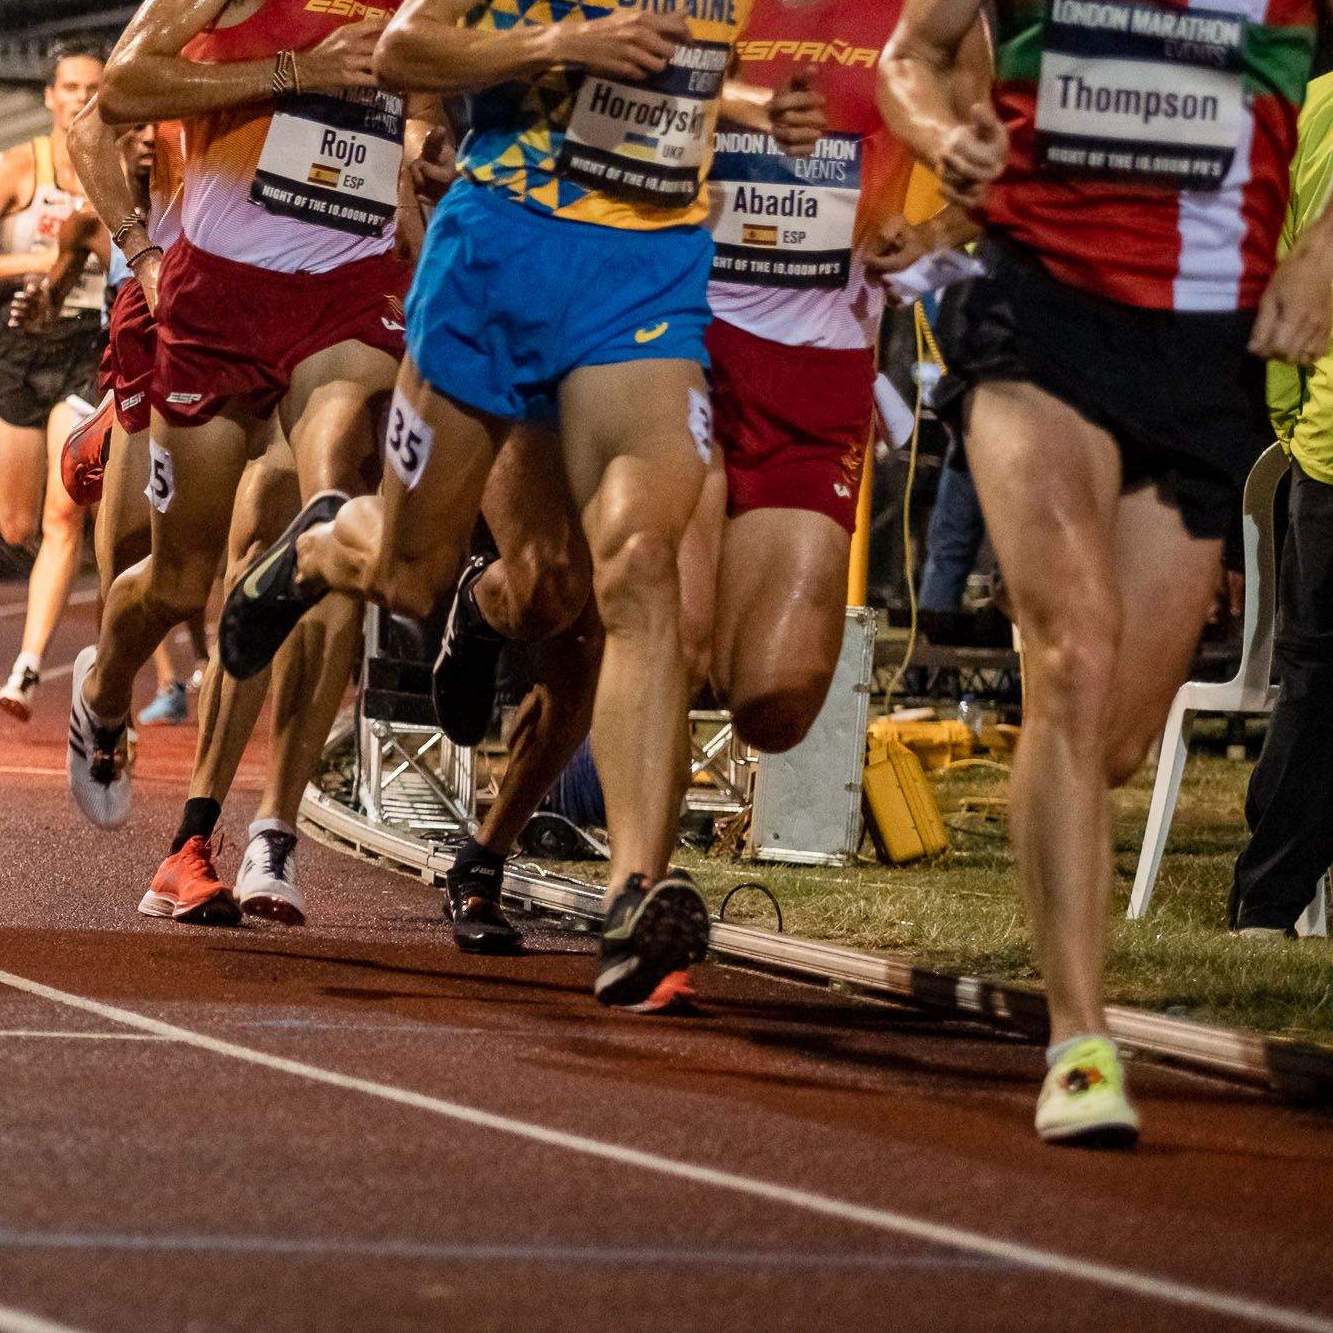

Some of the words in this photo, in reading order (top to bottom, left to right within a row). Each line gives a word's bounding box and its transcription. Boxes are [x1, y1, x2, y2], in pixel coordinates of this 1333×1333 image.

[1058, 74, 1219, 124] Thompson
[319, 129, 367, 167] Rojo
[343, 174, 365, 190] ESP
[794, 159, 846, 182] EVENTS
[261, 184, 294, 204] NIGHT
[293, 194, 307, 208] OF
[308, 198, 327, 213] THE
[733, 186, 818, 218] Abadía
[782, 230, 807, 244] ESP
[734, 258, 748, 271] OF
[750, 260, 771, 273] THE
[120, 391, 146, 412] ESP
[165, 391, 203, 405] ESP
[389, 407, 423, 472] 35
